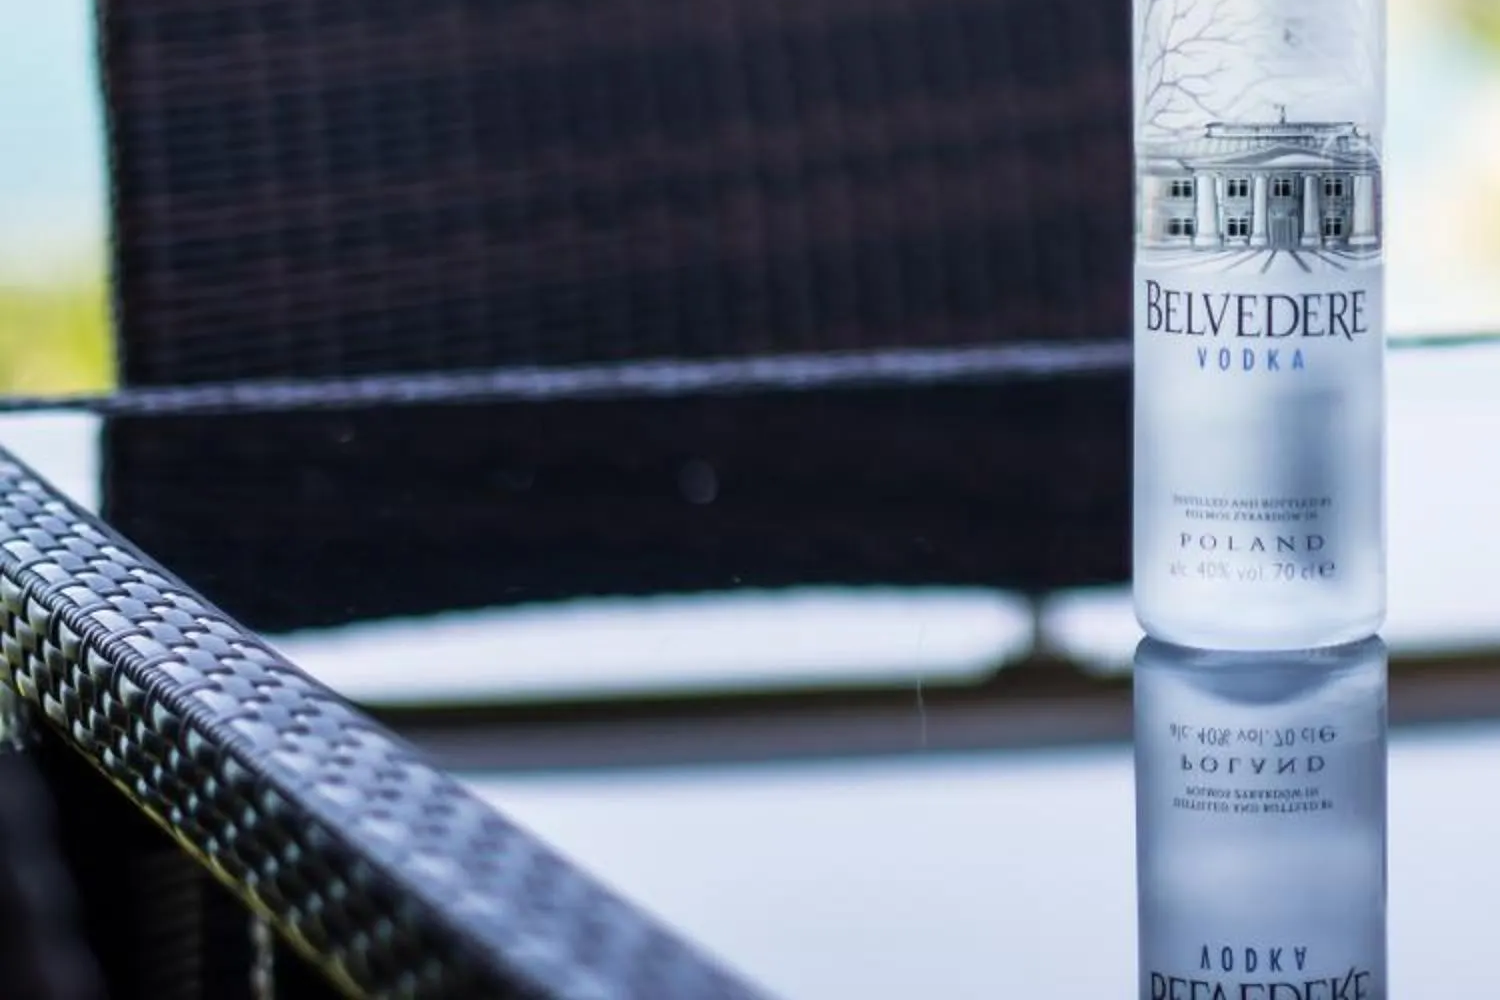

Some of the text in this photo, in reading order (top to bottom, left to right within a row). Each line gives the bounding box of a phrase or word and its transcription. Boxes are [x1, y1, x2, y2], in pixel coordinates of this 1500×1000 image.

[1146, 279, 1369, 341] BELVEDERE
[1197, 347, 1305, 371] VODKA
[1180, 532, 1326, 552] POLAND
[1272, 562, 1295, 580] 70
